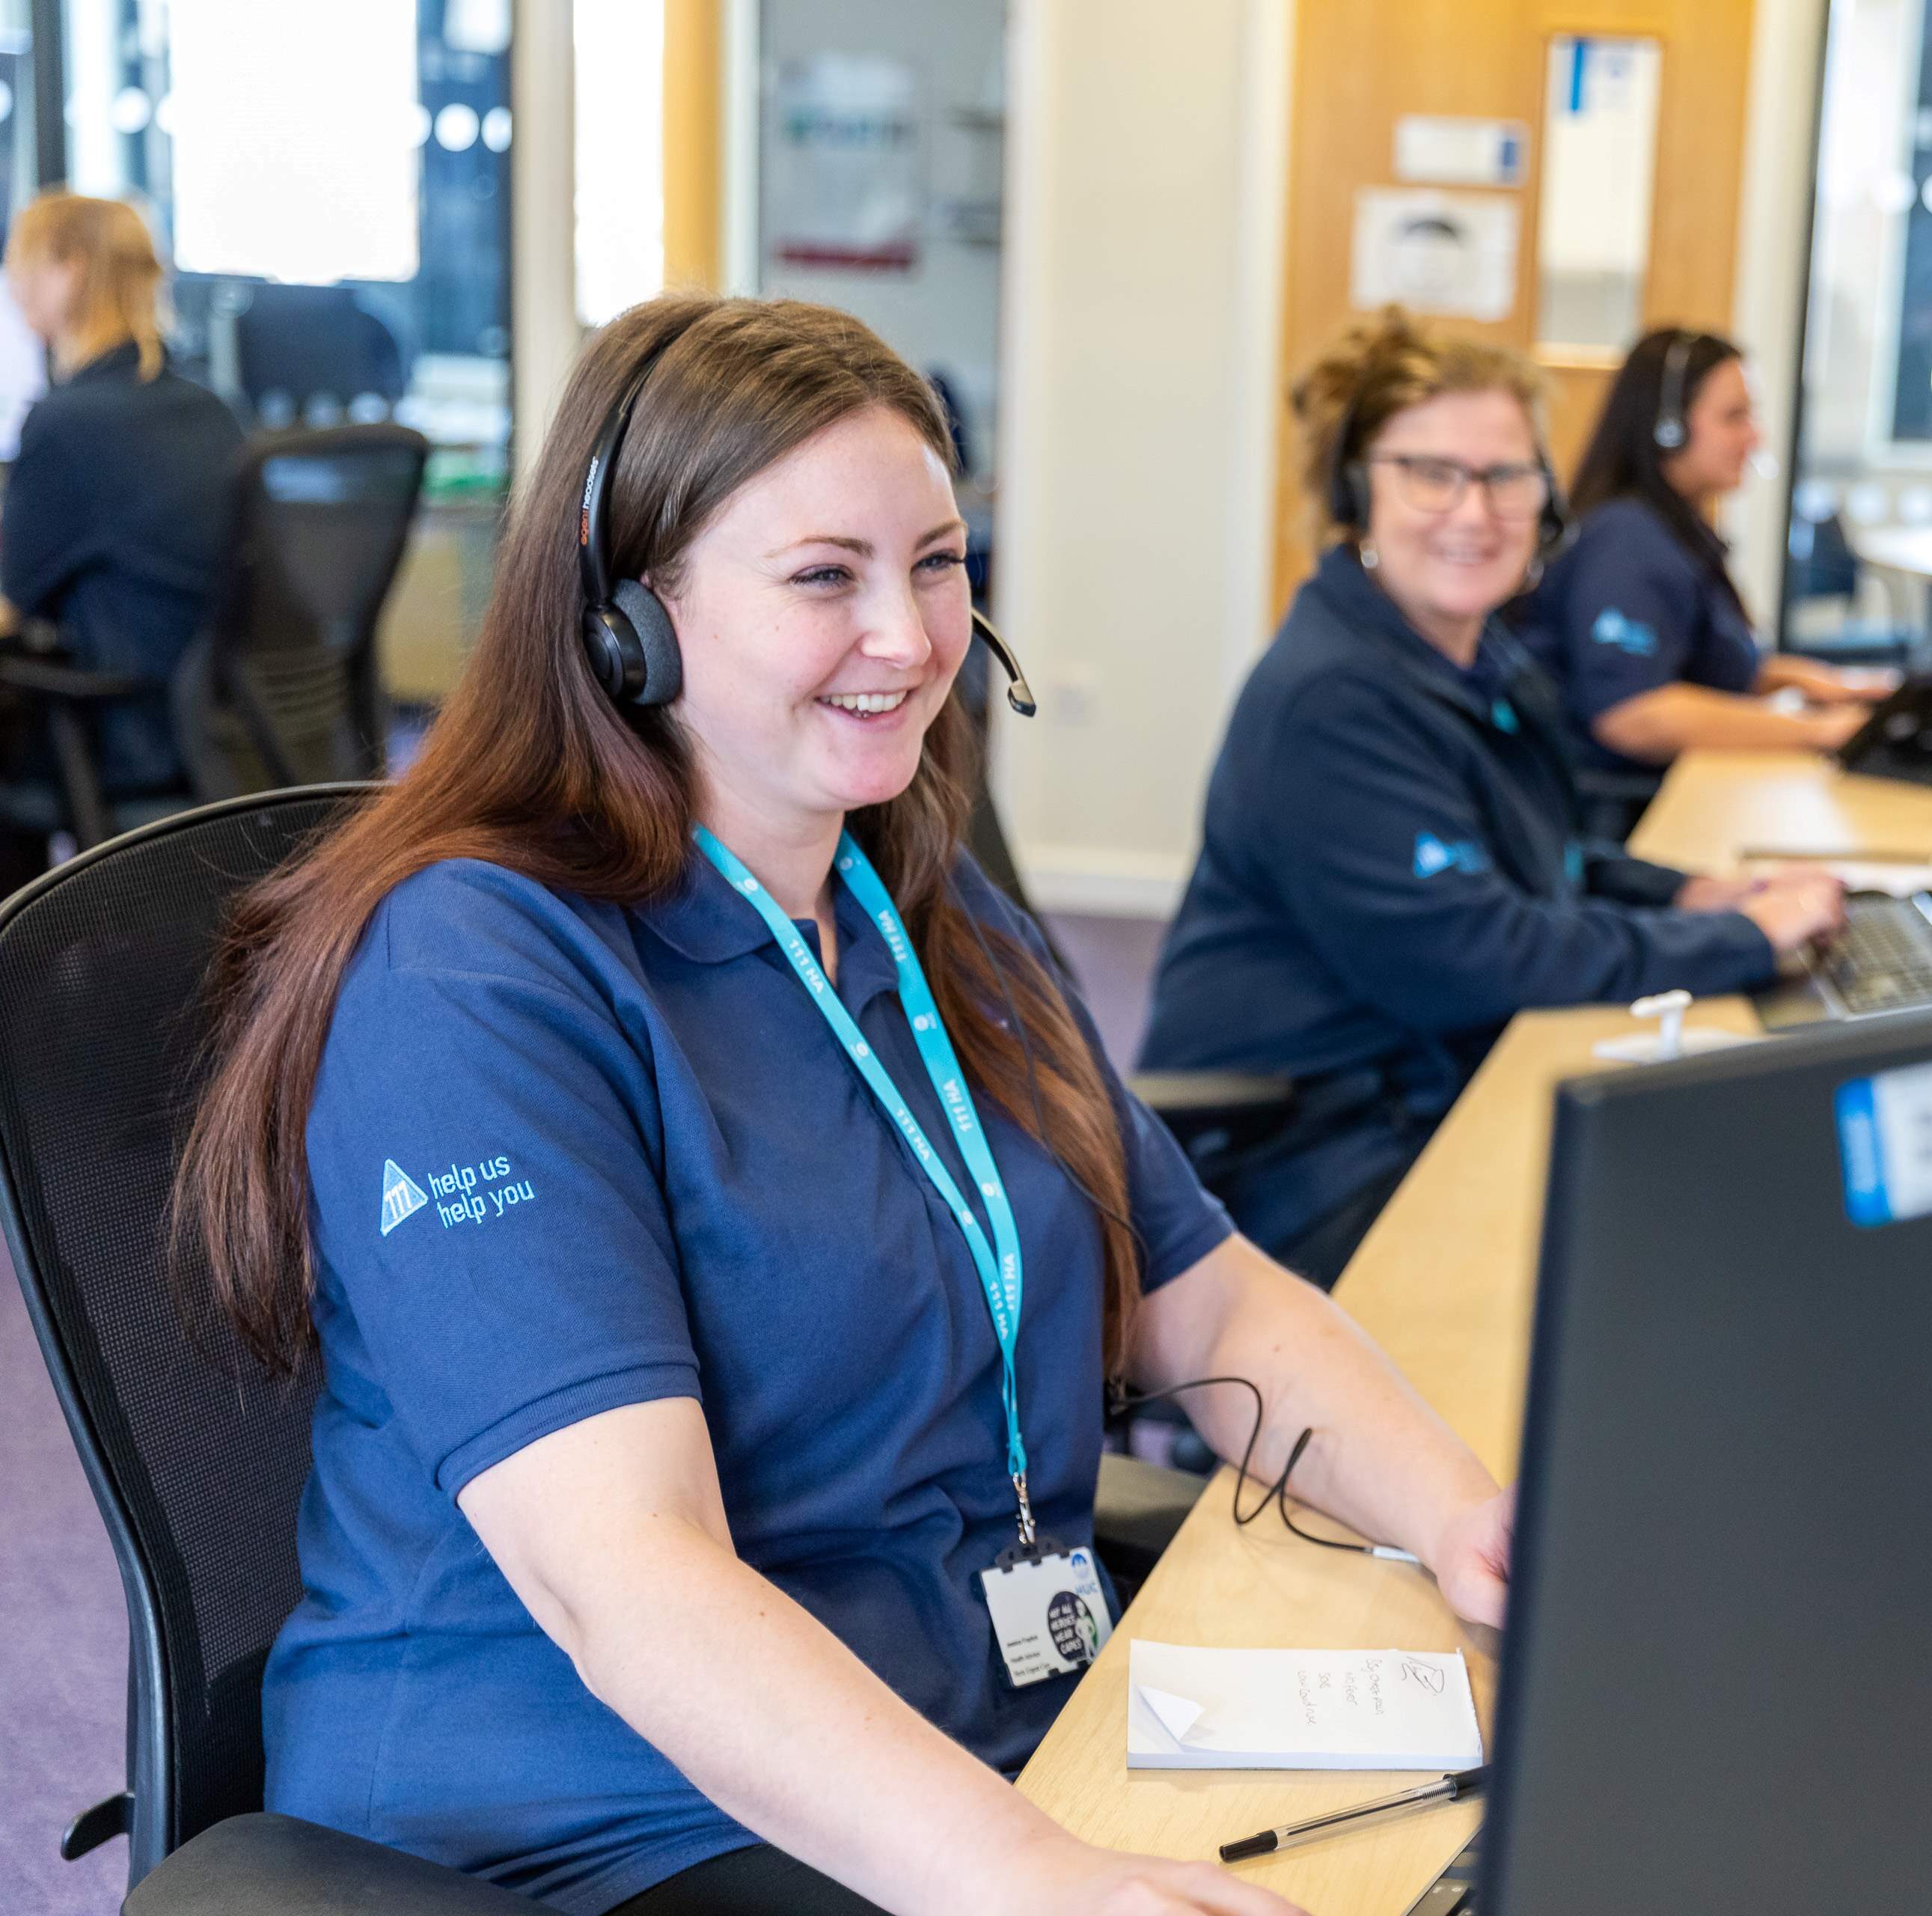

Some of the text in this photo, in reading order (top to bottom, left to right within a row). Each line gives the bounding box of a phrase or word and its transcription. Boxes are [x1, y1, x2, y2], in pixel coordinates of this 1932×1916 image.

[427, 1156, 510, 1199] help us
[436, 1180, 536, 1229] help you
